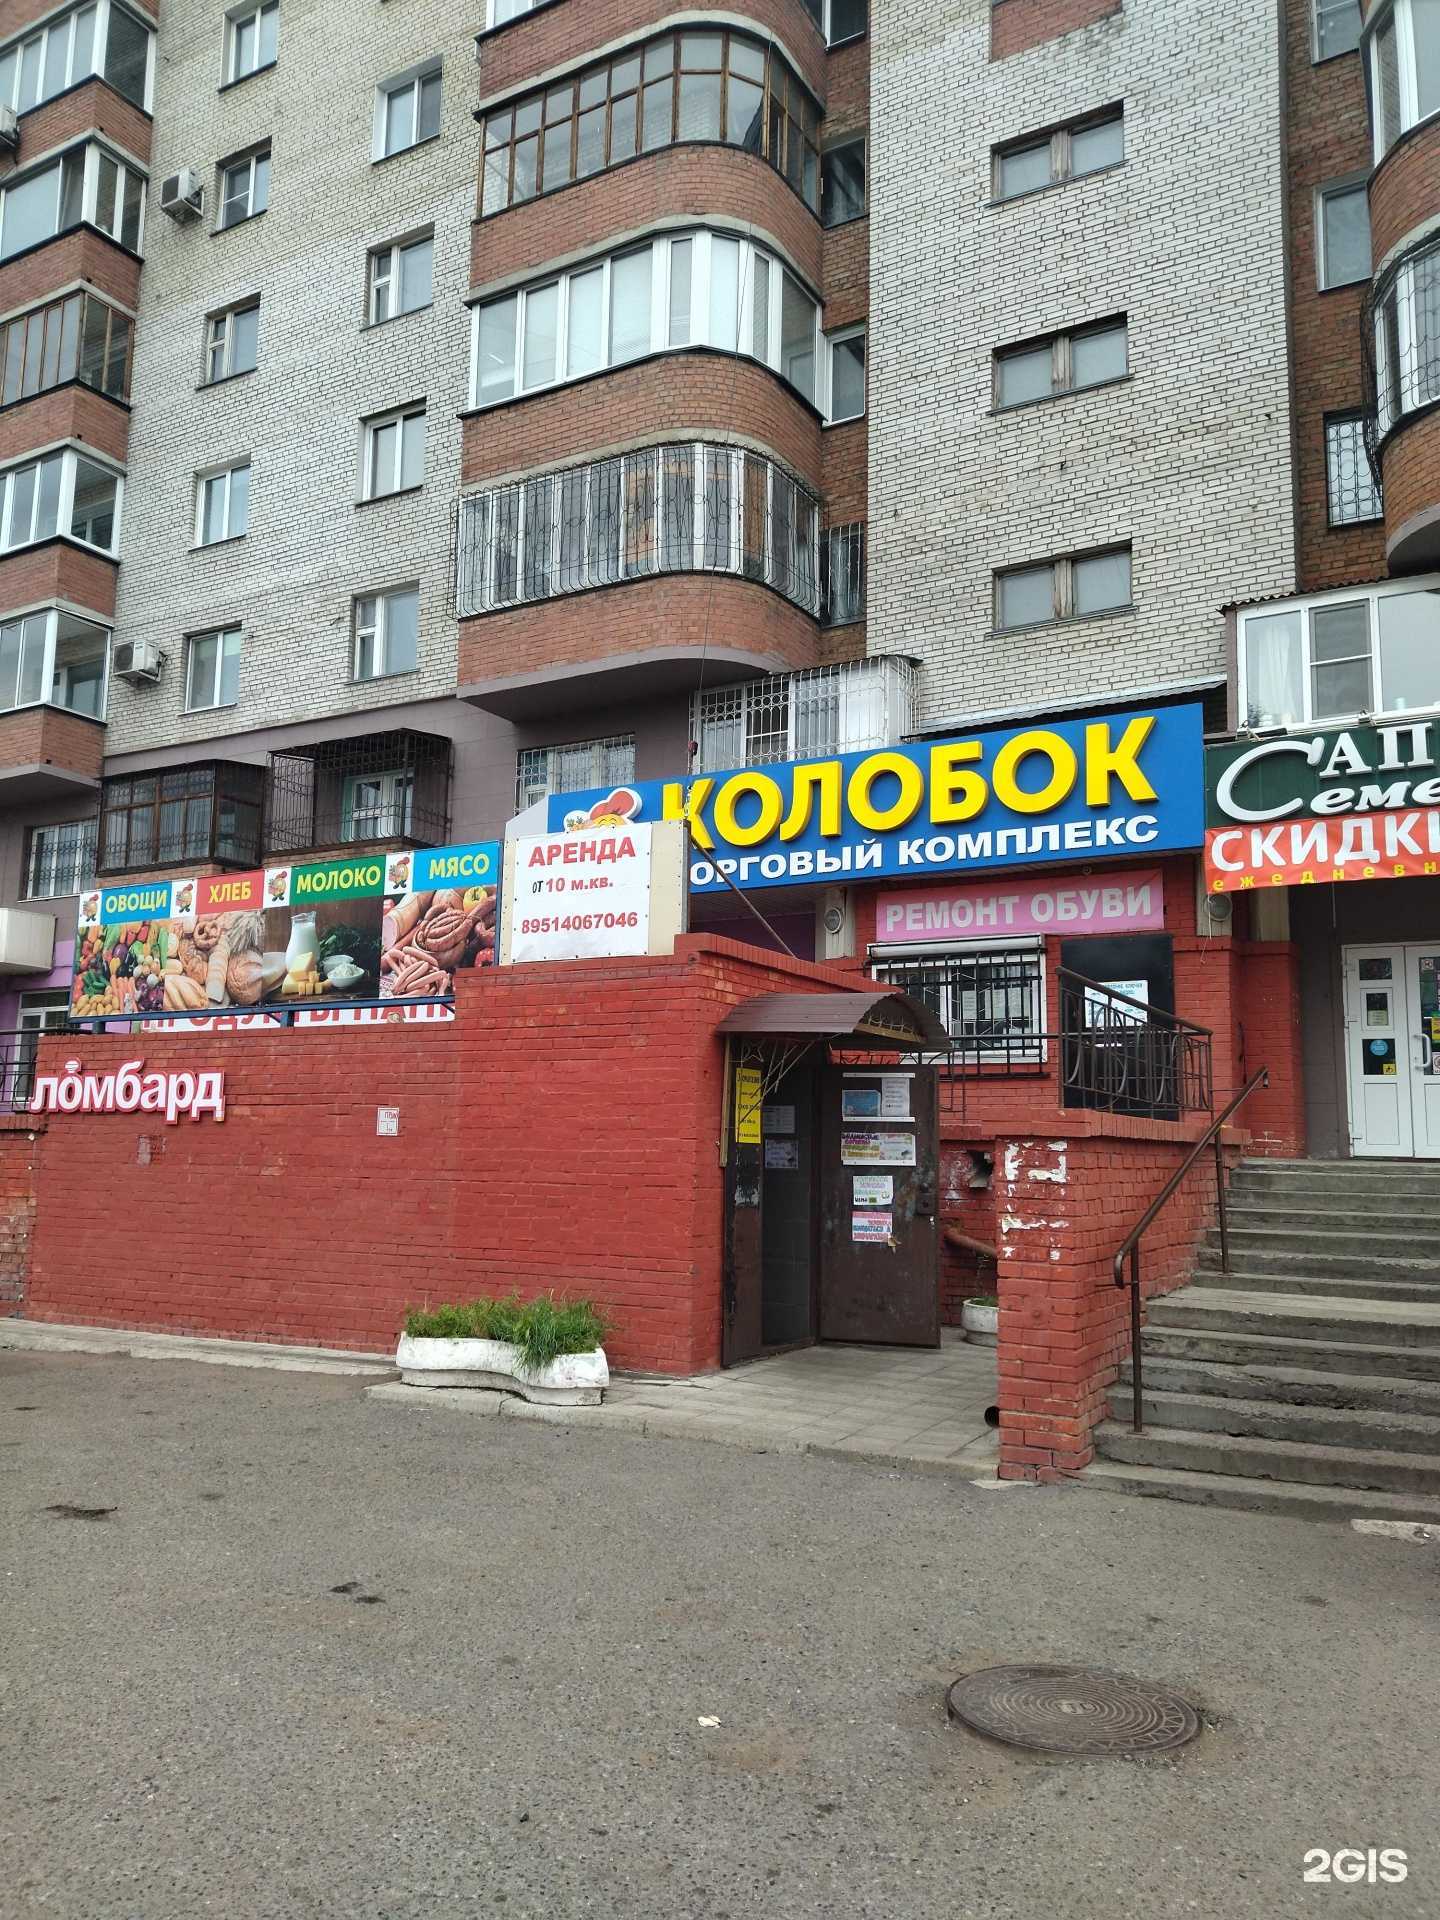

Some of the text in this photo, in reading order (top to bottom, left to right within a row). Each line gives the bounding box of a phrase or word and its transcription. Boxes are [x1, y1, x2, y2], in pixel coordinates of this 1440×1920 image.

[662, 716, 1158, 849] КОЛОБОК
[528, 836, 636, 867] АРЕНДА
[690, 815, 1158, 885] ОРГОВЫЙ КОМПЛЕКС
[296, 865, 381, 894] МОЛОКО
[429, 853, 490, 880] МЯСО
[208, 881, 252, 904] ХЛЕБ
[546, 877, 565, 892] 10
[105, 889, 168, 914] ОВОЩИ
[886, 885, 1152, 932] РЕМОНТ ОБУВИ
[521, 911, 638, 934] 89514067046
[29, 1058, 225, 1122] ломбард
